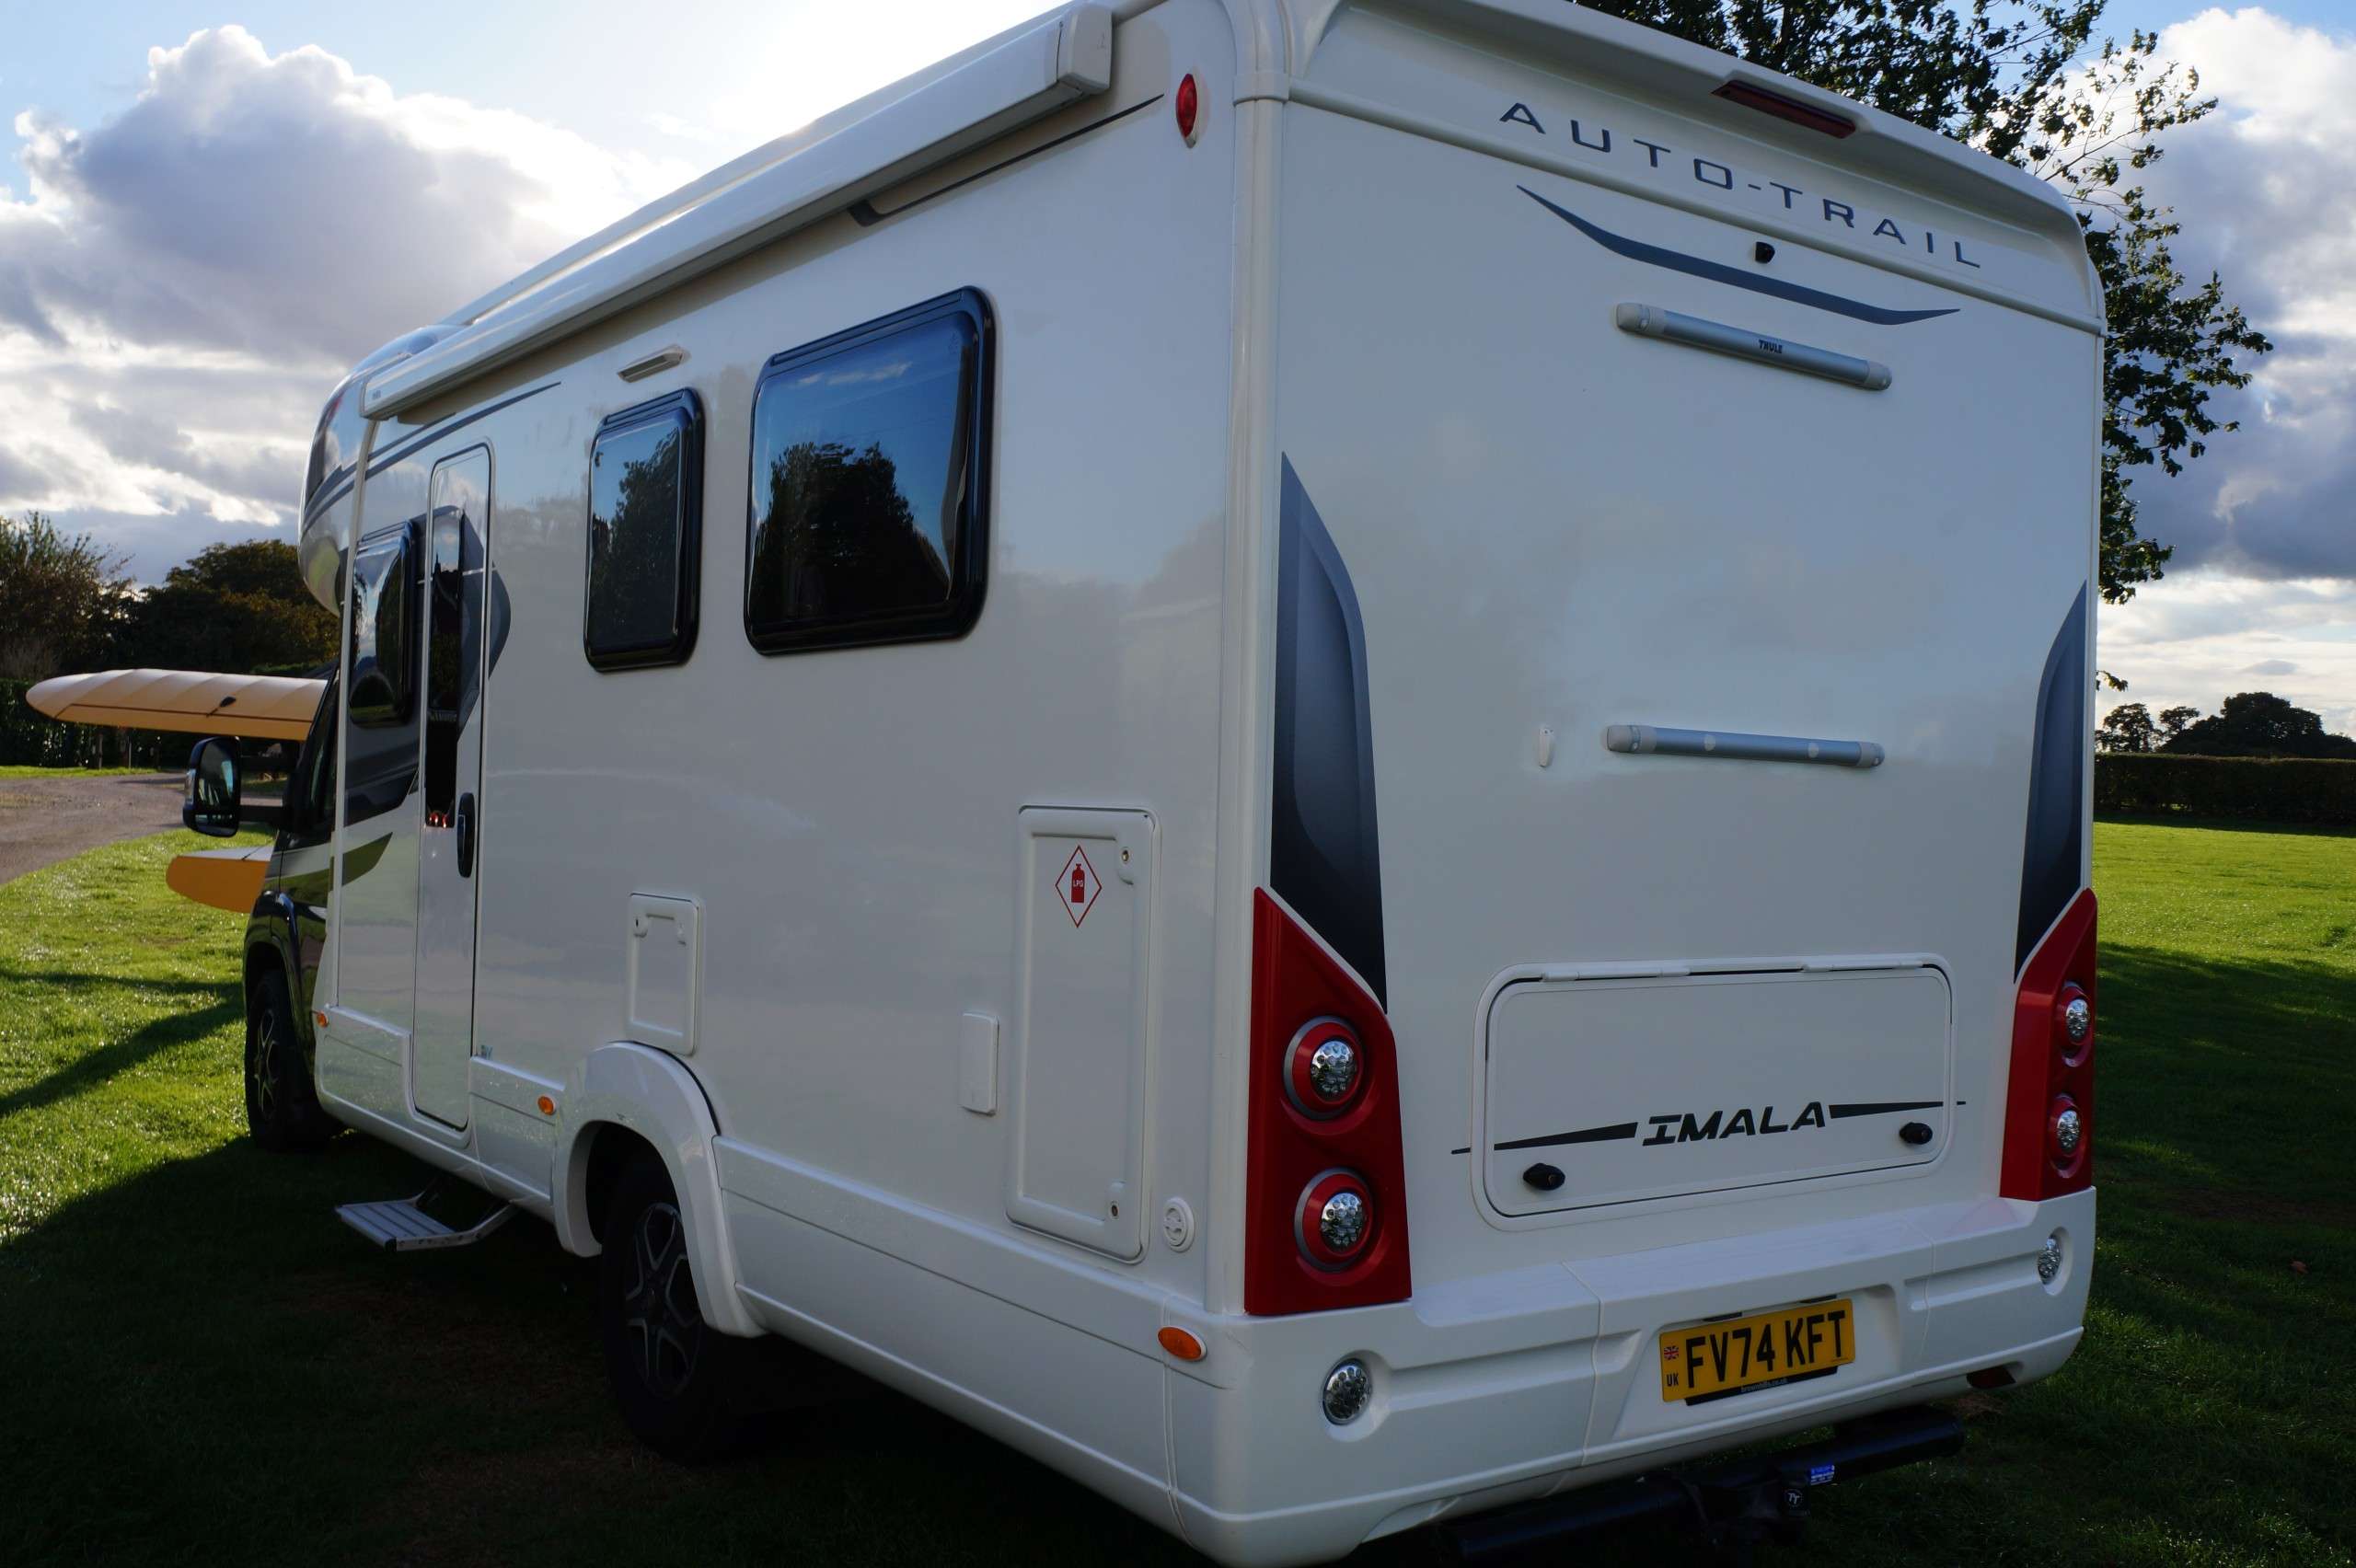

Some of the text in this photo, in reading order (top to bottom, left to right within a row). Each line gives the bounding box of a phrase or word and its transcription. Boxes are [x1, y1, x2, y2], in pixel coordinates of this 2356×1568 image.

[1499, 102, 1981, 269] AUTO-TRAIL
[1759, 340, 1783, 354] THULE
[1073, 879, 1084, 888] LPG
[1642, 1101, 1826, 1147] IMALA
[1685, 1309, 1846, 1389] FV74 KFT
[1667, 1372, 1680, 1387] UK
